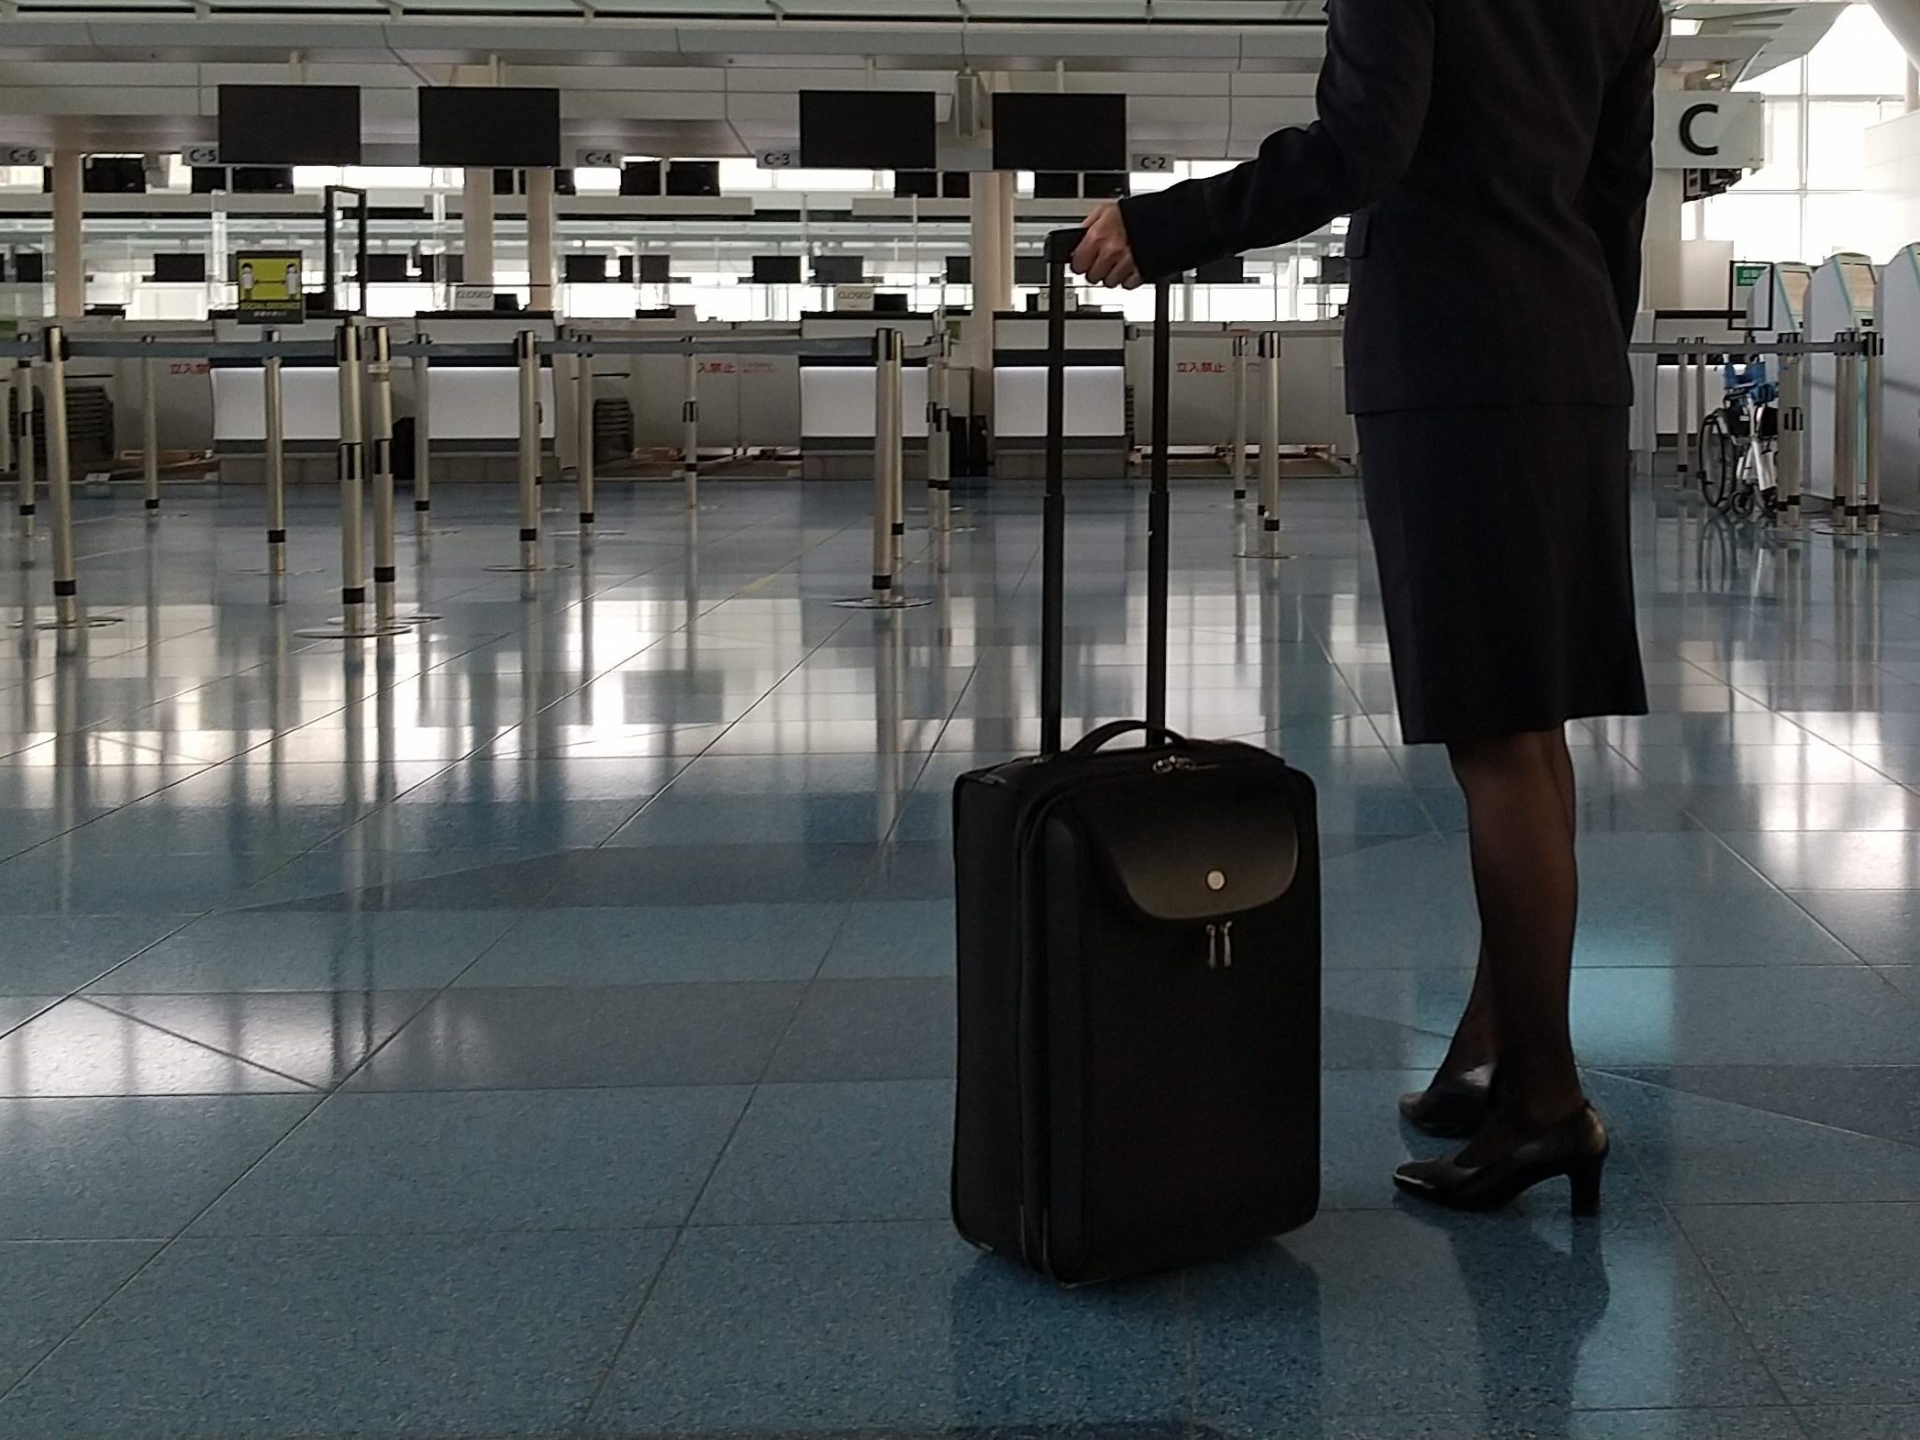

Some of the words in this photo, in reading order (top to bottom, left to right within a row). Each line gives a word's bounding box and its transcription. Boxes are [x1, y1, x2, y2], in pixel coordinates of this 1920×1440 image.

[1679, 103, 1718, 156] C
[9, 149, 37, 162] C-6
[189, 149, 216, 162] C-5
[585, 152, 612, 165] C-4
[764, 152, 791, 165] C-3
[1140, 156, 1166, 169] C-2
[837, 291, 871, 300] CLOSED
[1176, 361, 1226, 373] 立入禁止
